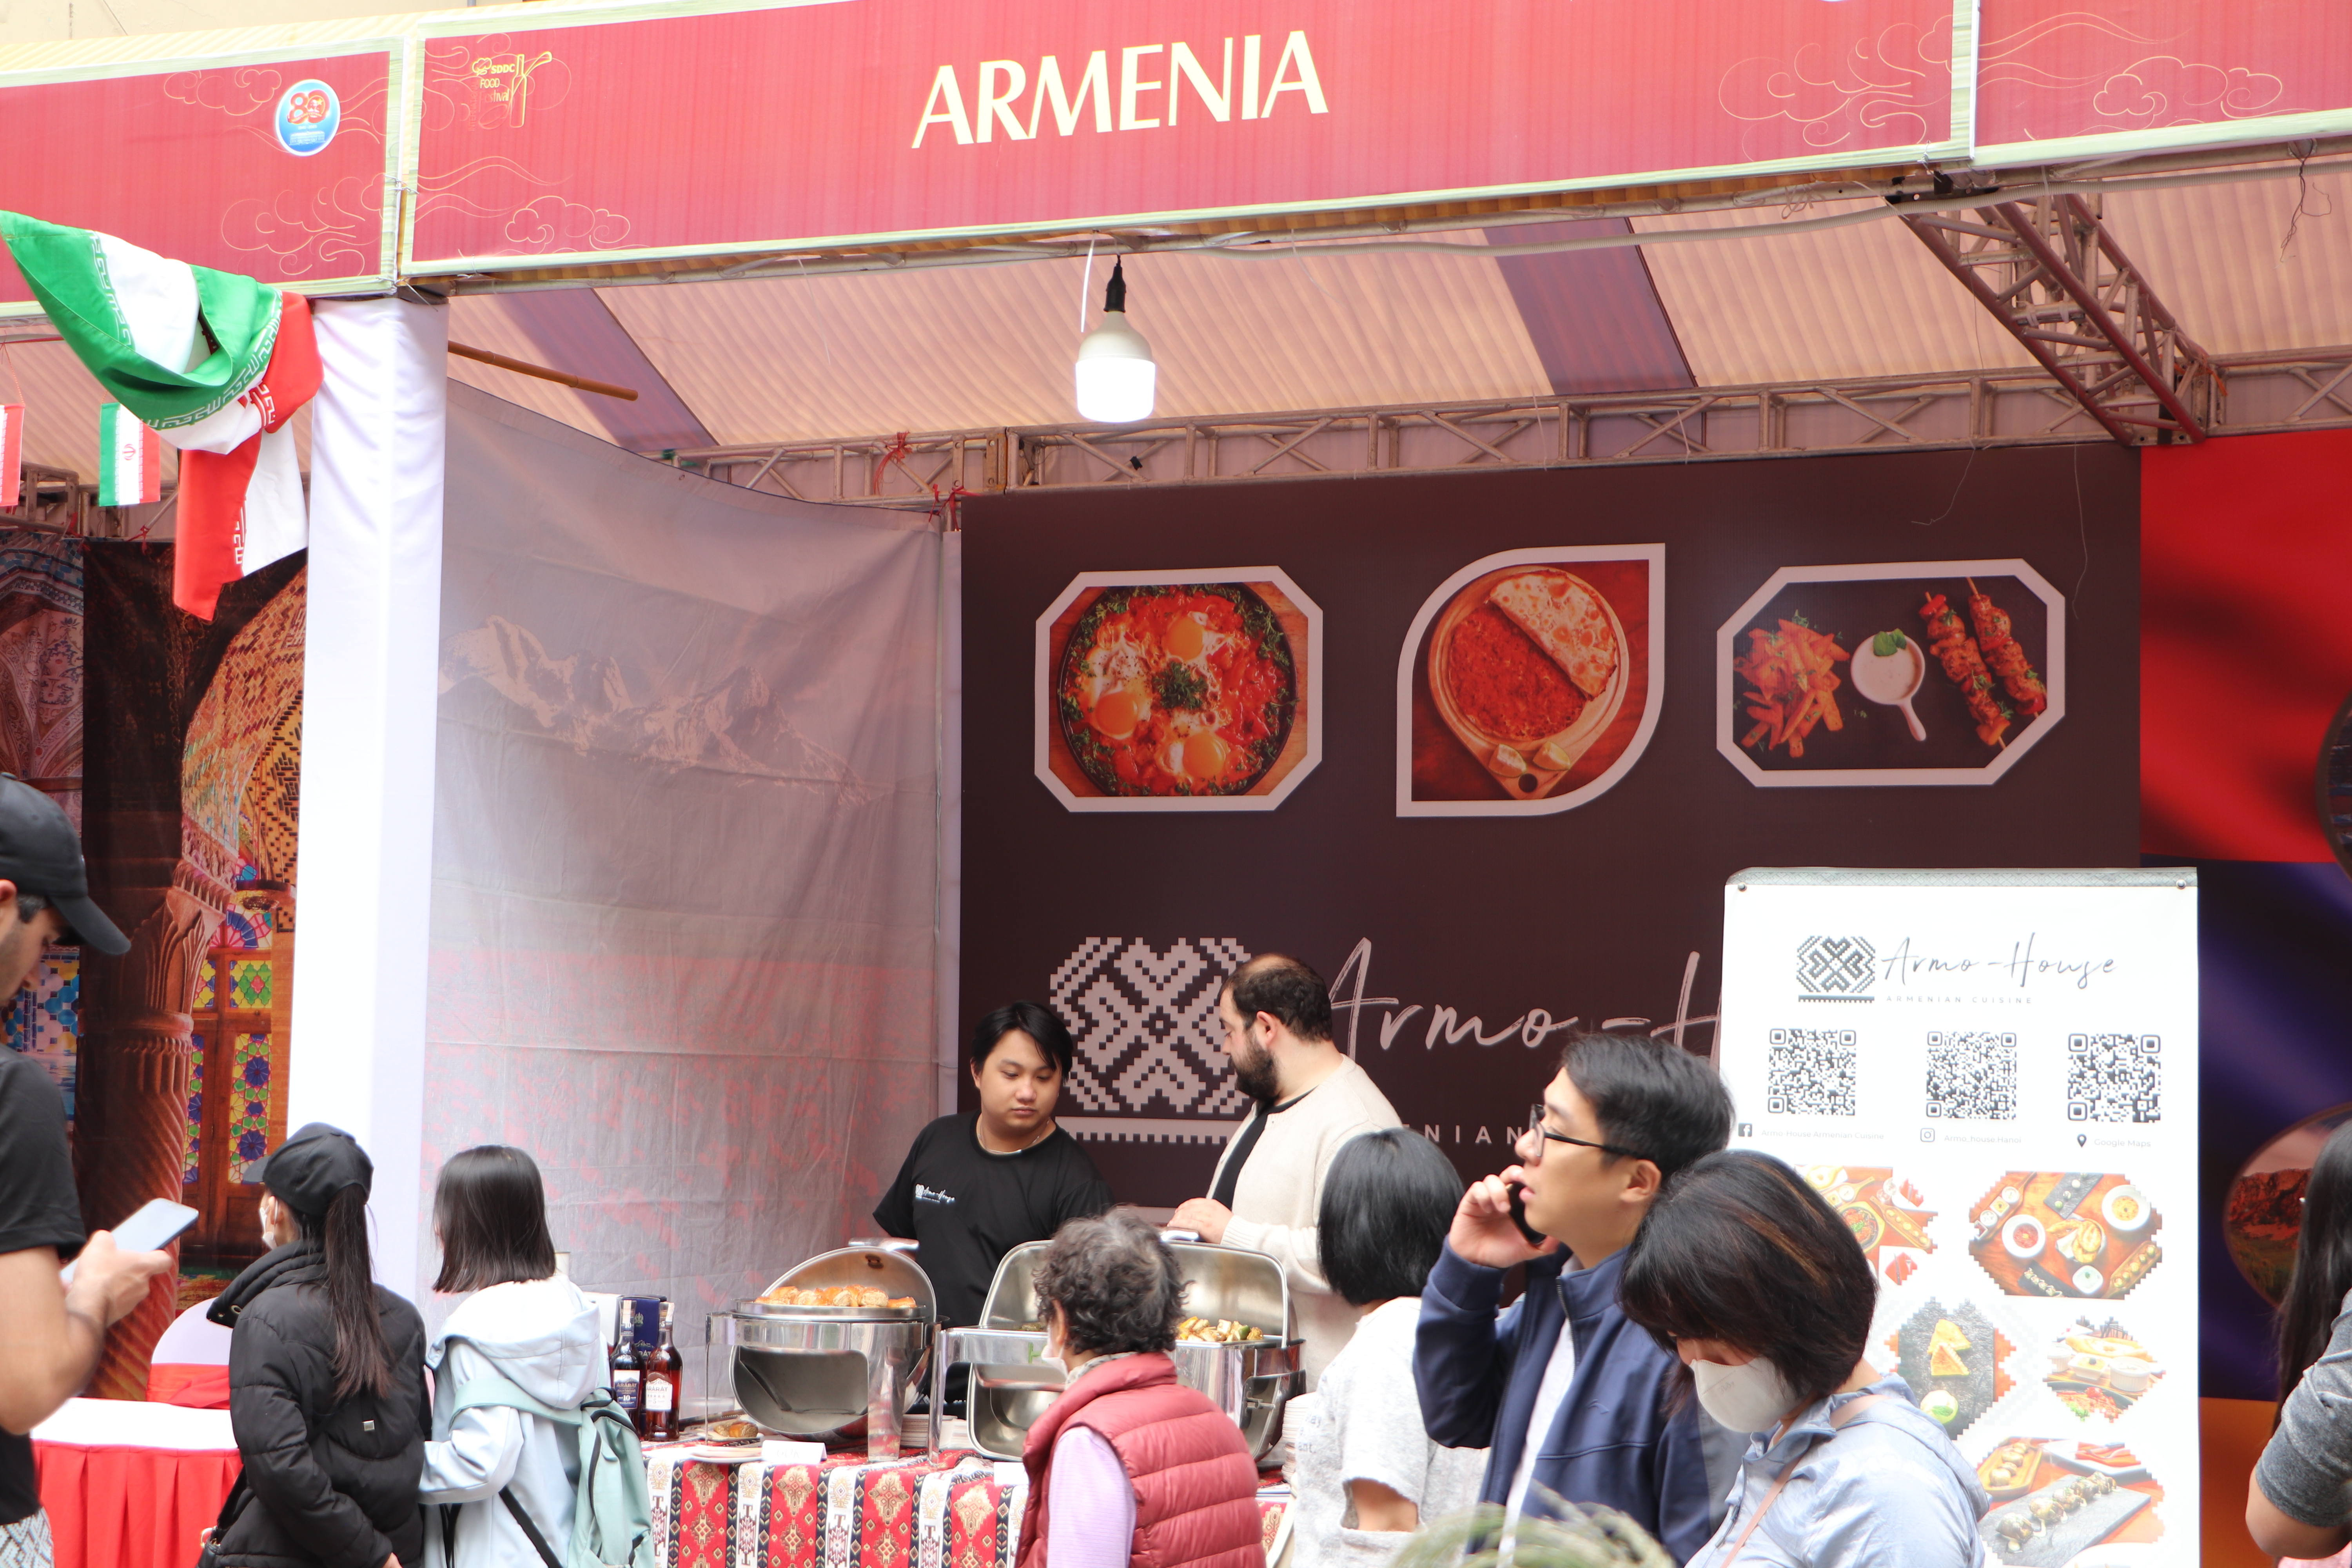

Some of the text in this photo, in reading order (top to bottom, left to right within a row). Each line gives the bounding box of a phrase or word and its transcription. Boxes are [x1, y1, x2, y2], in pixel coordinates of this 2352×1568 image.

[491, 64, 515, 74] SDDC
[480, 78, 500, 89] FOOD
[911, 30, 1329, 149] ARMENIA
[288, 89, 330, 125] 80
[479, 88, 510, 113] Festival
[1402, 1123, 1522, 1145] NIAN
[1944, 1135, 2022, 1143] Armo_house.Hanoi
[2094, 1138, 2125, 1147] Google
